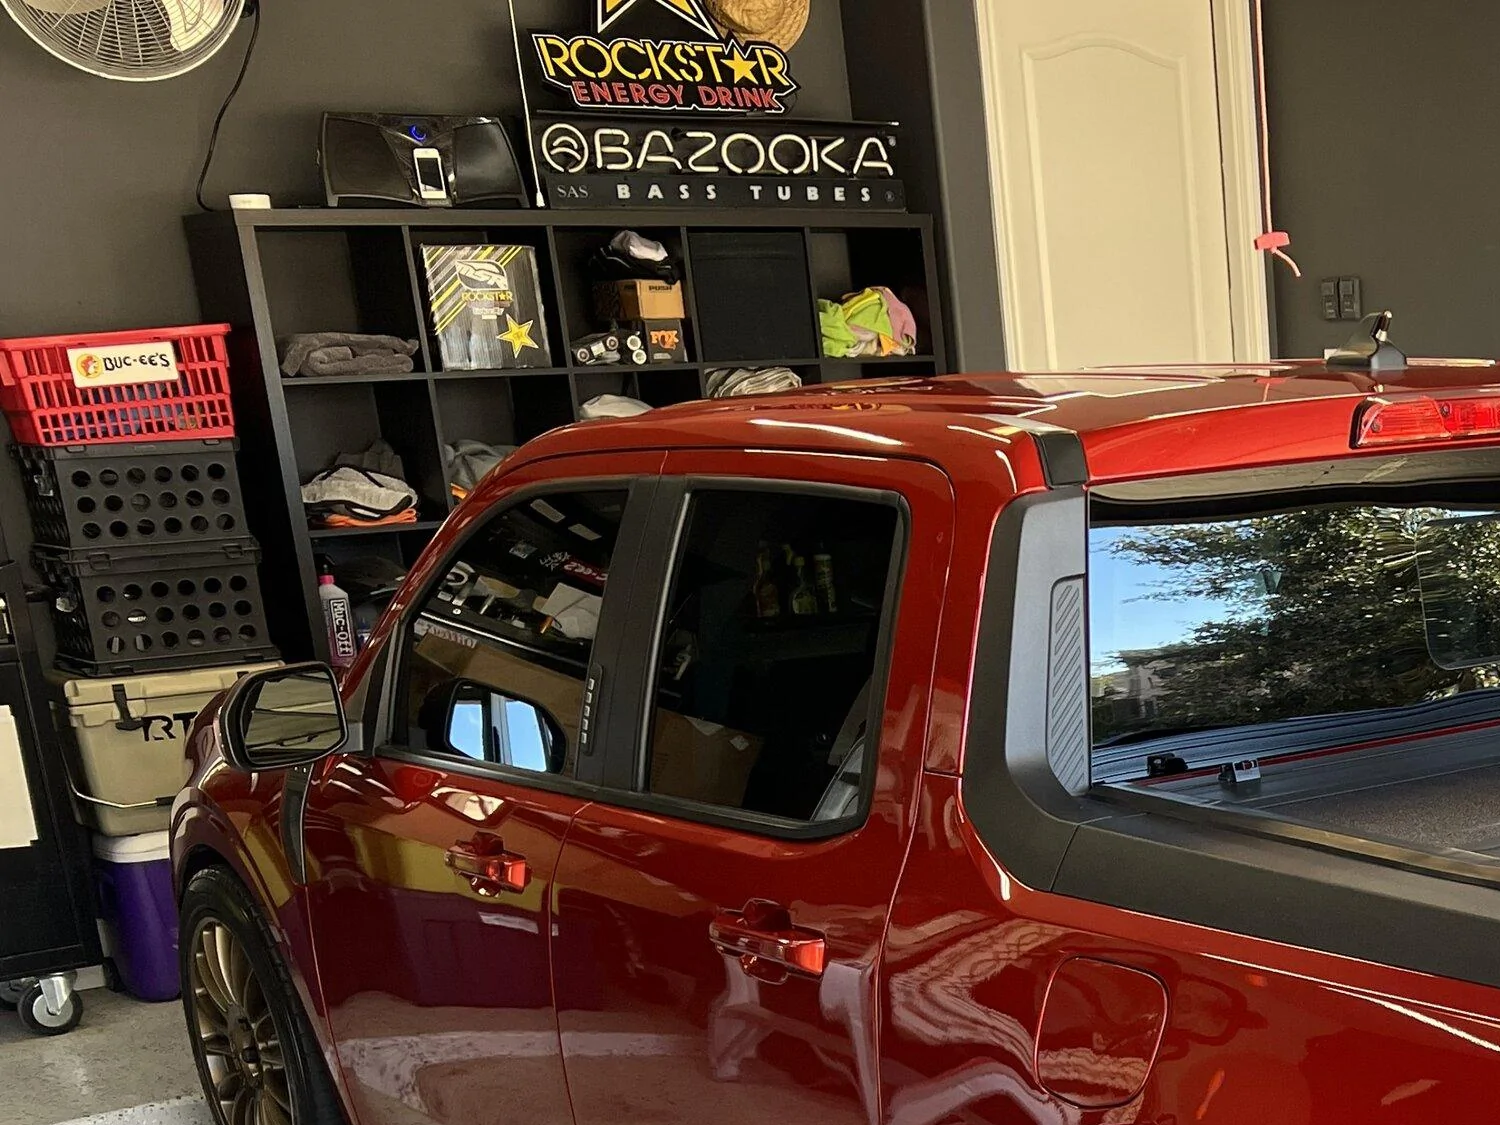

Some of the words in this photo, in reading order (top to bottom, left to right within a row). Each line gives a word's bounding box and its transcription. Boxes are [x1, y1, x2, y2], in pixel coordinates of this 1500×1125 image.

[571, 80, 684, 105] ENERGY
[696, 85, 779, 108] DRINK
[594, 128, 894, 176] BAZOOKA
[557, 185, 589, 198] SAS
[616, 183, 718, 200] BASS
[749, 185, 871, 202] TUBES
[650, 330, 680, 350] FOX
[141, 711, 198, 742] RT
